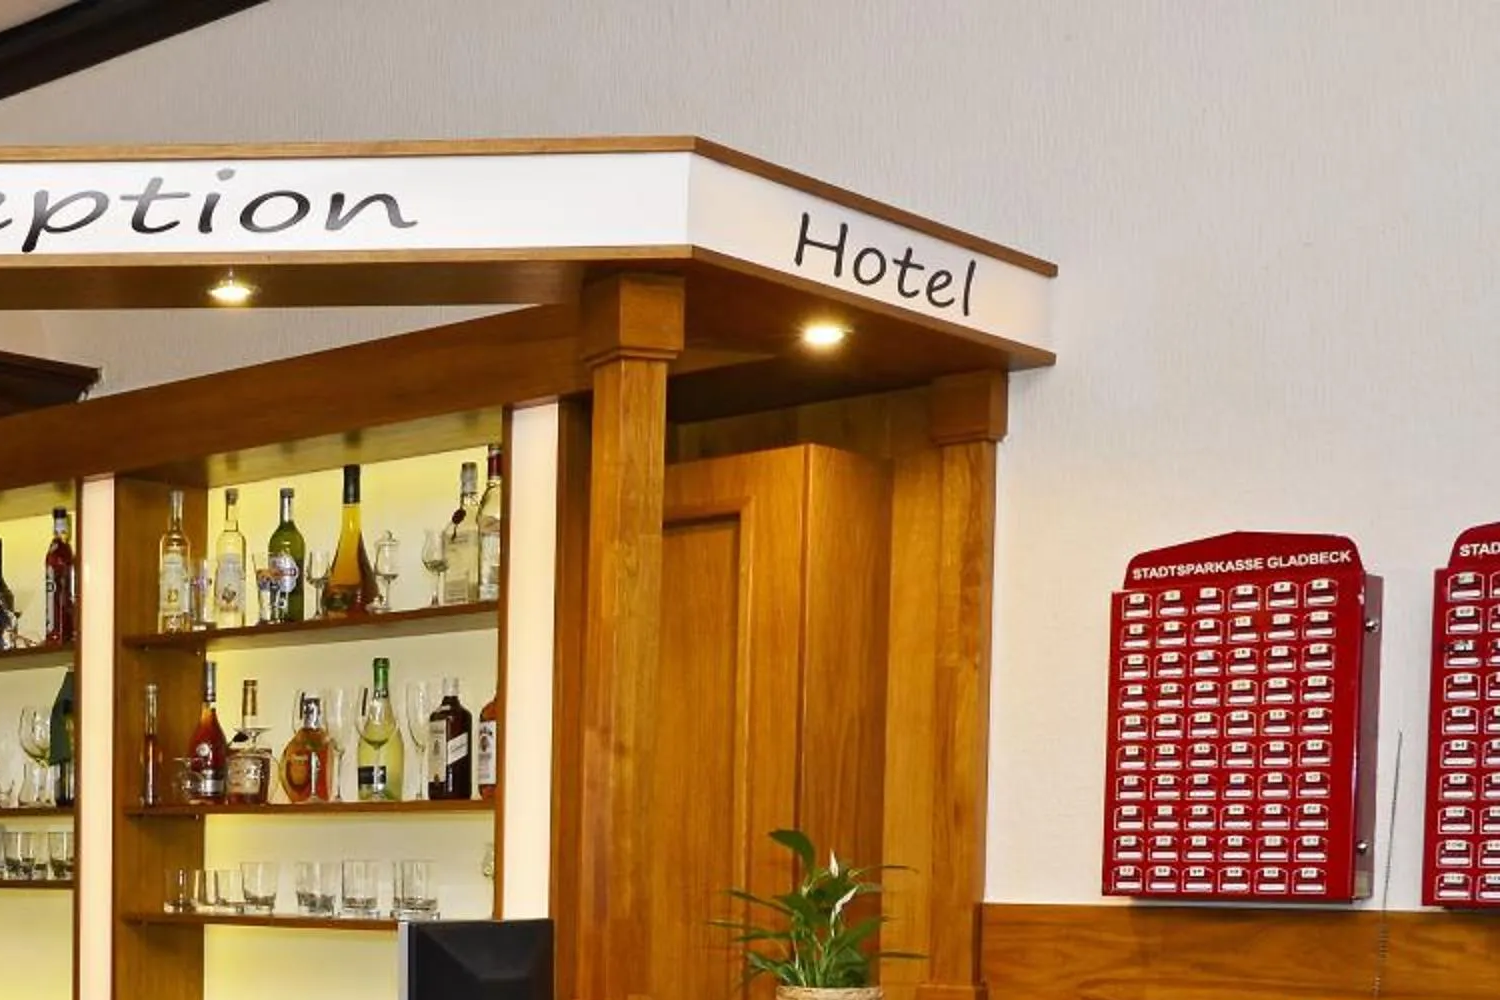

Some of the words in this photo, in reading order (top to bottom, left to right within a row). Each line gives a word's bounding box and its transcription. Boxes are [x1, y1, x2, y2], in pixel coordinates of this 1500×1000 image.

[794, 211, 977, 317] Hotel
[1133, 557, 1264, 580] STADTSPARKASSE
[1267, 549, 1352, 569] GLADBECK
